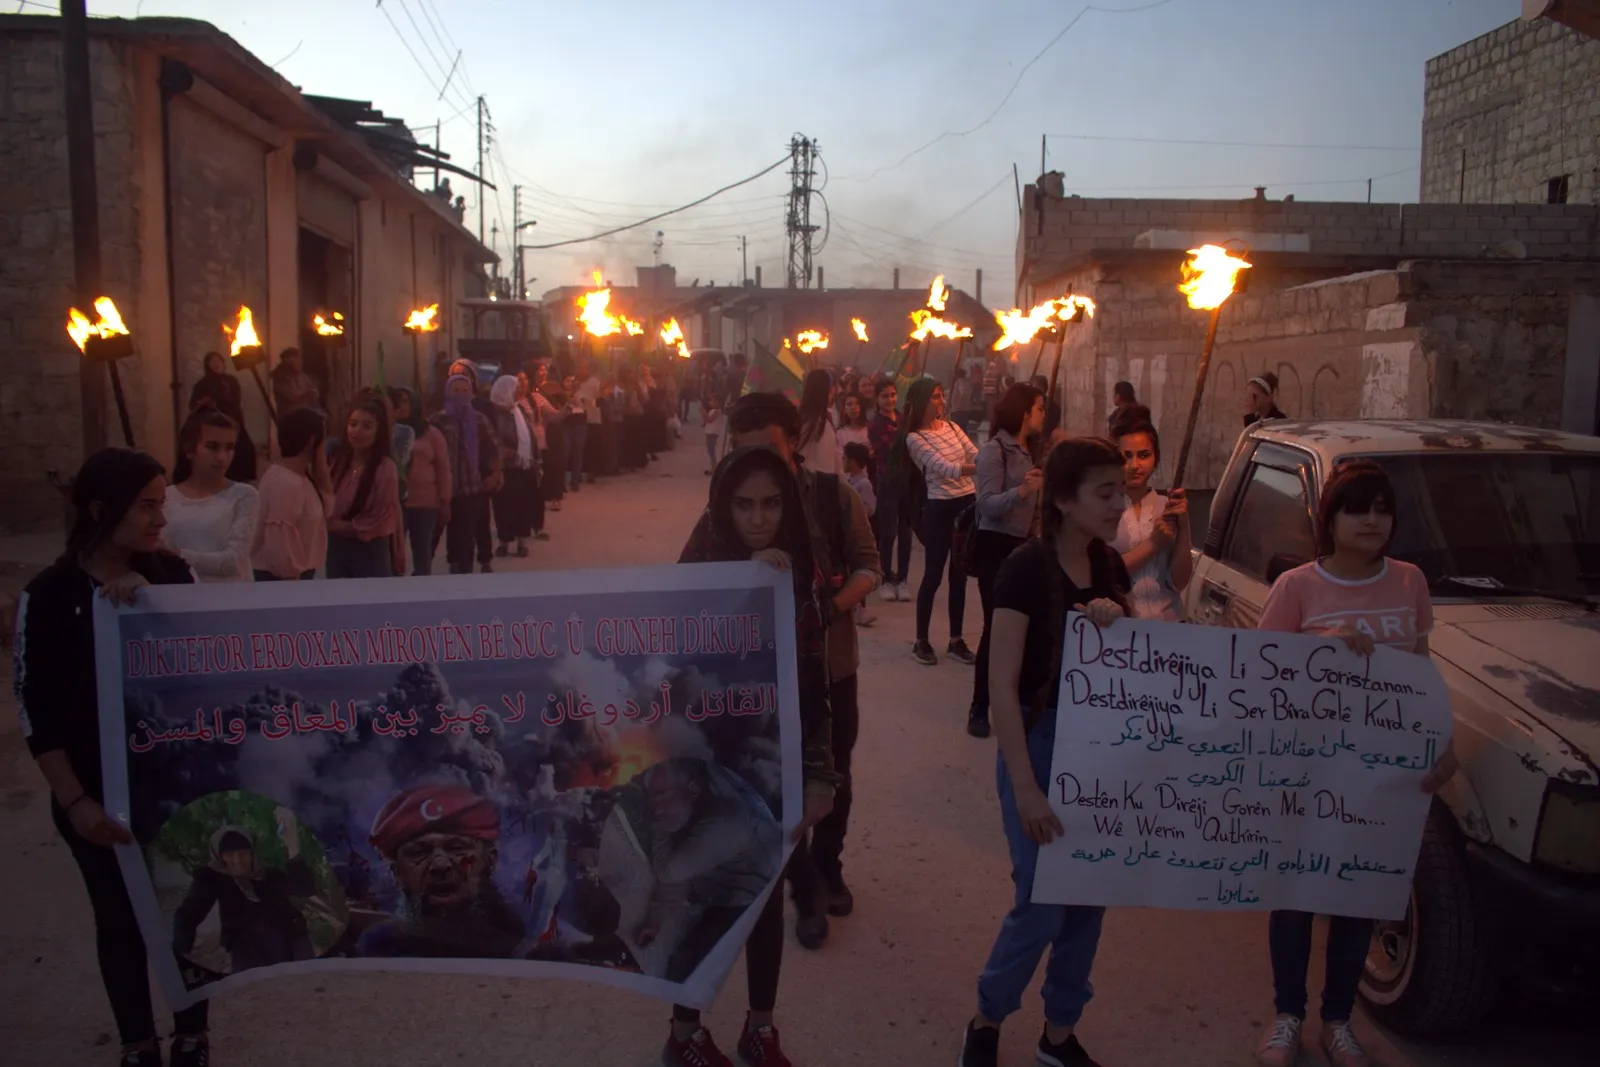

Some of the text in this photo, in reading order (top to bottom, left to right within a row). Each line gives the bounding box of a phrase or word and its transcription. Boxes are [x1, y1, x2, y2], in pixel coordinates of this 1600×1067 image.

[250, 629, 360, 671] ERDOXAN
[595, 617, 677, 656] GUNEH
[1072, 615, 1217, 700] Destdirêjiya
[1230, 634, 1246, 679] Li
[1259, 643, 1300, 681] Ser
[129, 680, 776, 753] القاتل أردوغان لا يميز بين المعاق والمسن
[1065, 669, 1184, 737] Destdirêjiya
[1200, 682, 1218, 718] Li
[1228, 689, 1267, 720] Ser
[1187, 728, 1252, 757] التعدي
[1359, 738, 1437, 770] التعدي
[1187, 757, 1245, 788] الكردي
[1056, 772, 1118, 809] Destên
[1123, 780, 1144, 811] Ku
[1280, 790, 1305, 816] Me
[1093, 814, 1124, 837] Wê
[1136, 814, 1185, 840] Werin
[1228, 848, 1270, 877] التي
